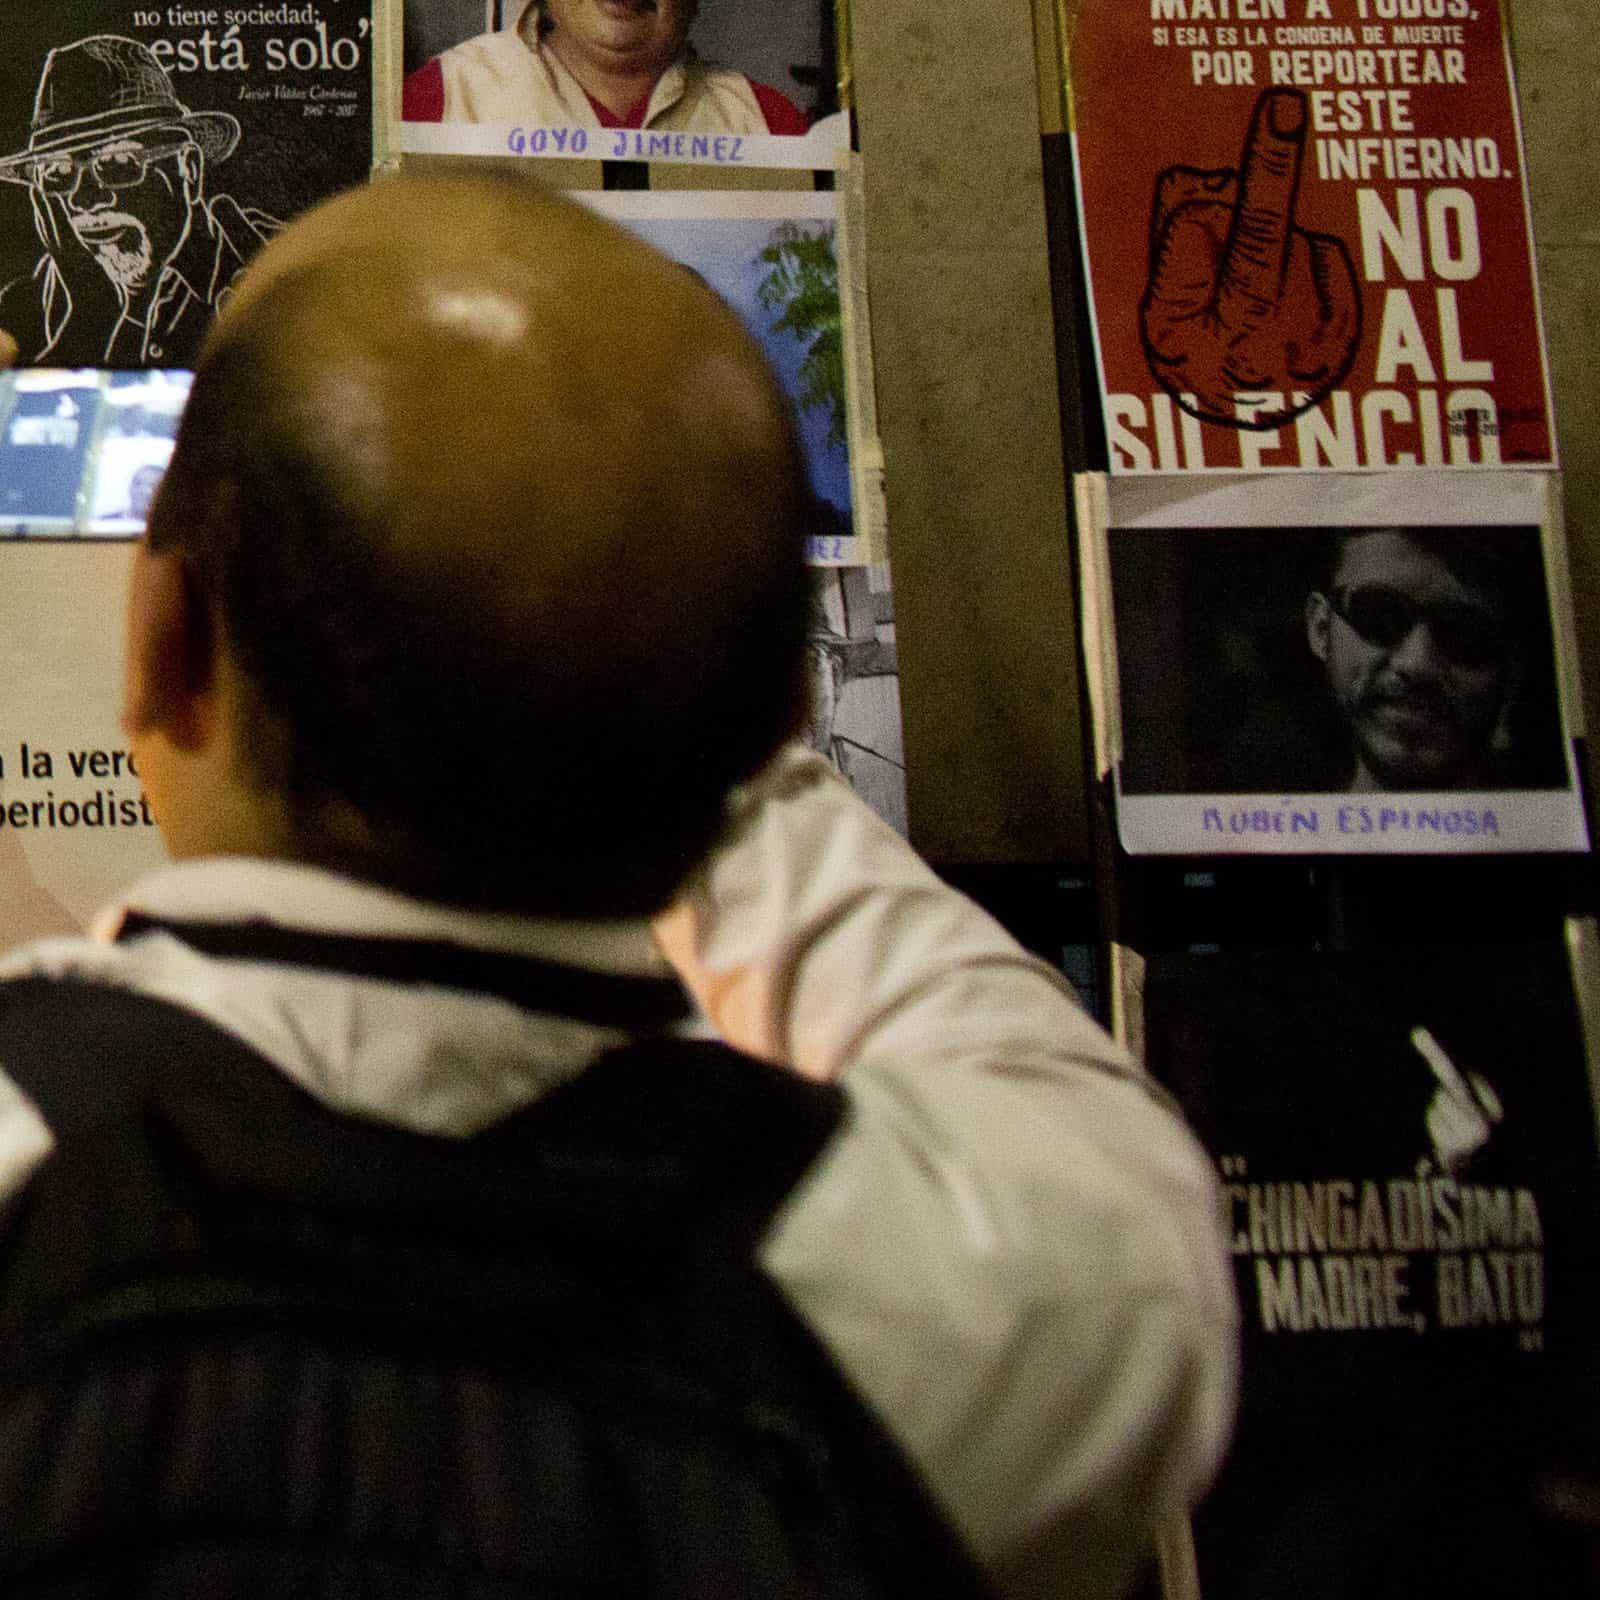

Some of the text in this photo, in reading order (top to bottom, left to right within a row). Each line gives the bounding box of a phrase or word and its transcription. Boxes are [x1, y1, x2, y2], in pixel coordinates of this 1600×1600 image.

[1191, 49, 1467, 87] POR REPORTEAR
[1310, 90, 1415, 132] ESTE
[507, 126, 745, 162] GOYO JIMENEZ
[1314, 137, 1513, 180] INFIERNO.
[1355, 187, 1482, 282] NO
[1374, 288, 1494, 383] AL
[1106, 389, 1503, 470] SILENCIO
[20, 743, 54, 778] la
[1336, 806, 1501, 835] ESPINOSA
[1256, 1253, 1427, 1334] MADRE,
